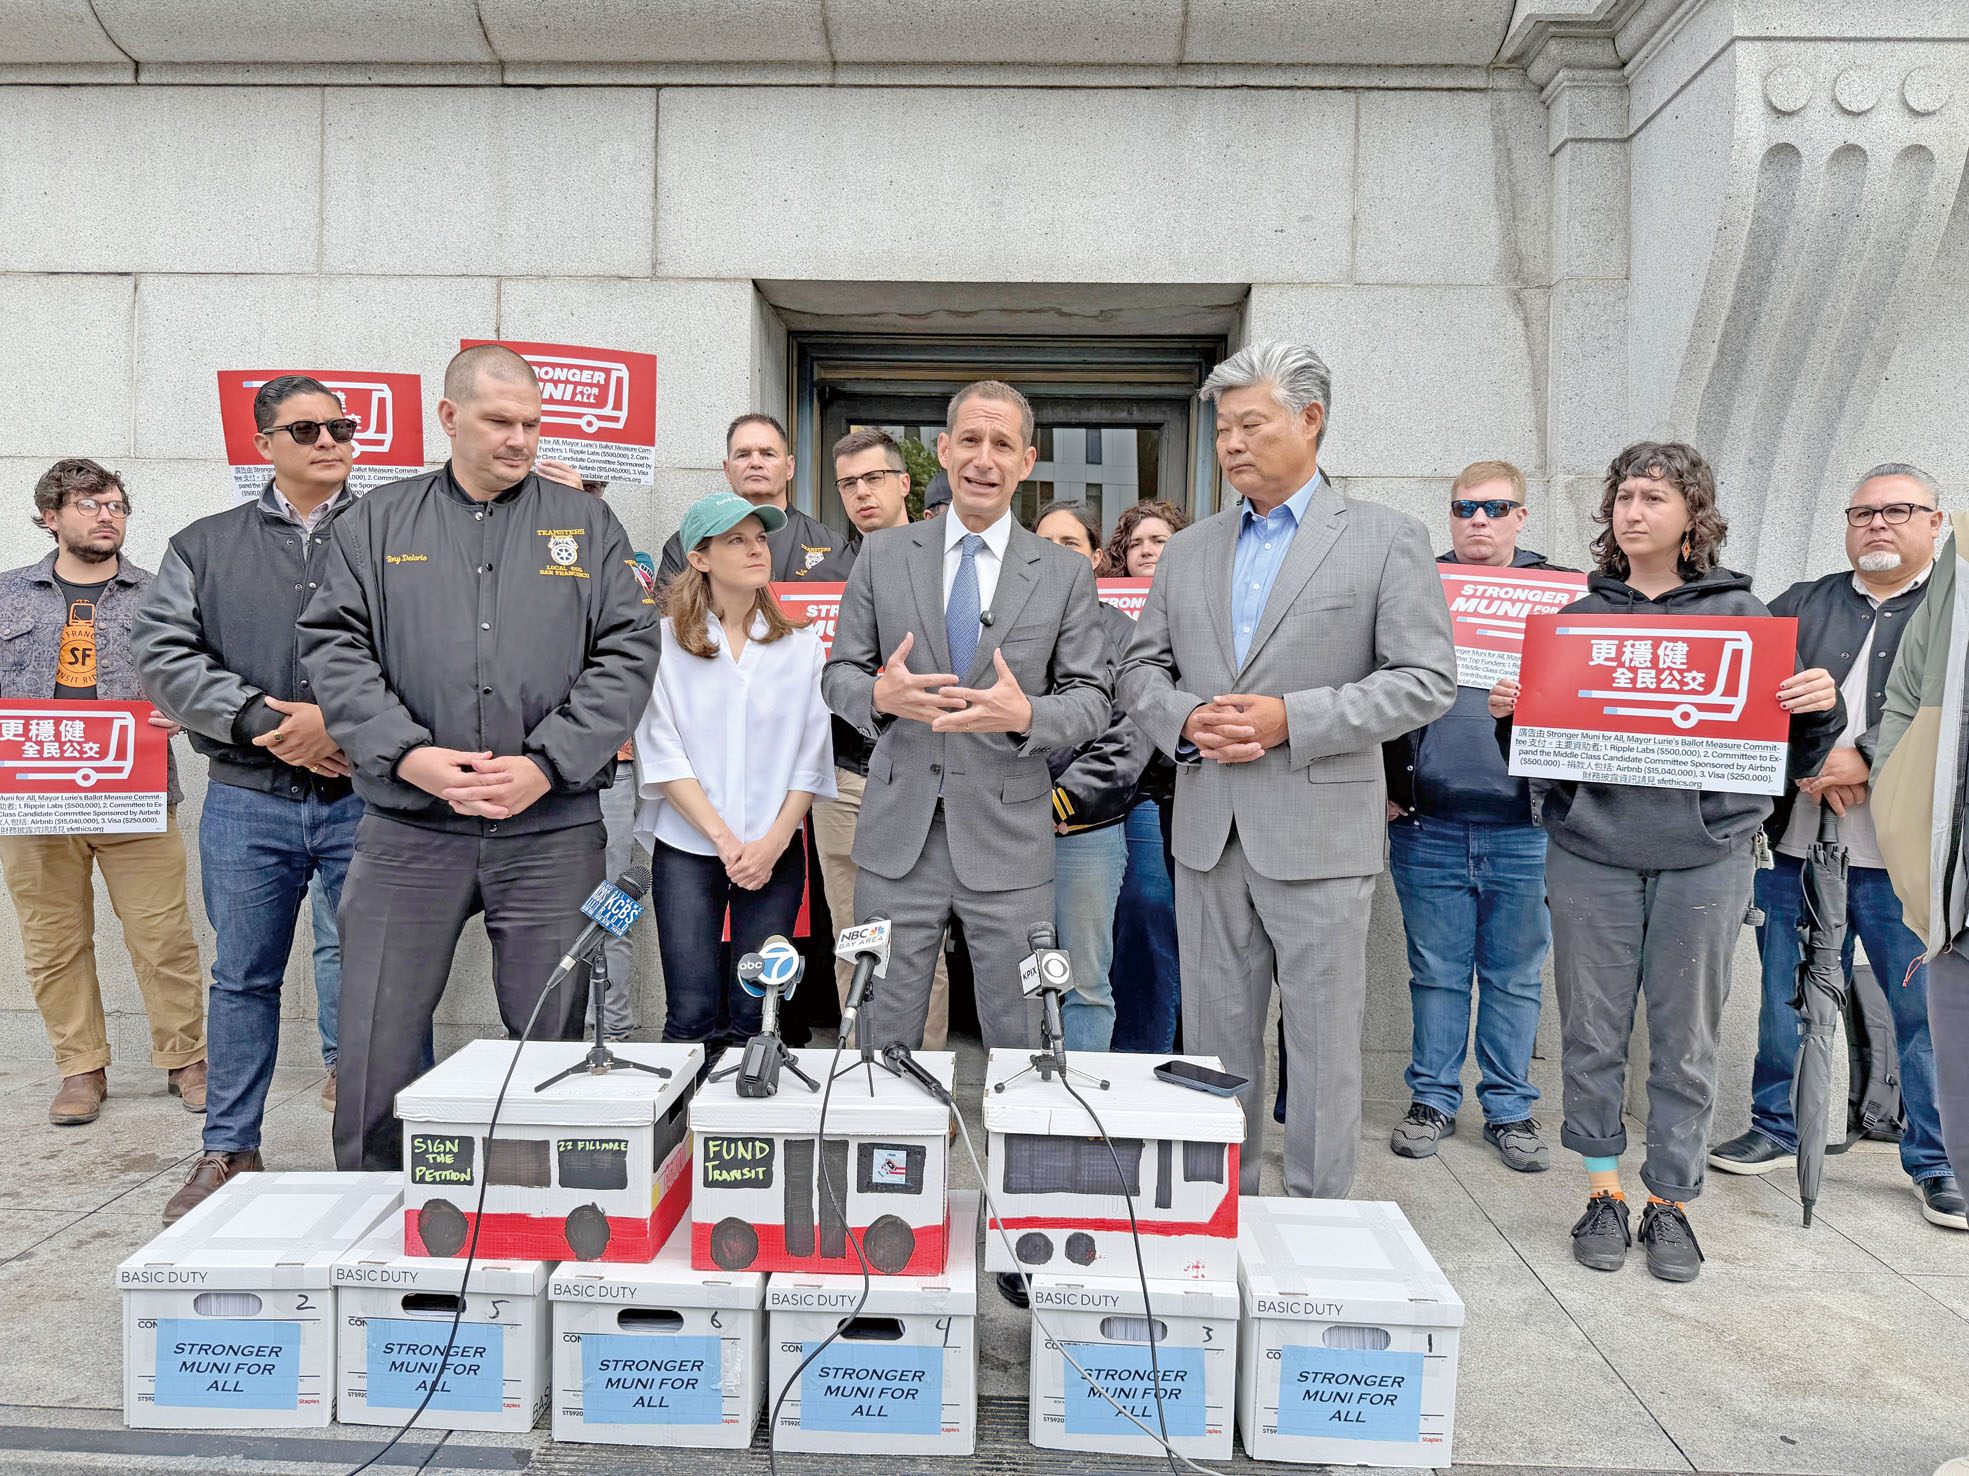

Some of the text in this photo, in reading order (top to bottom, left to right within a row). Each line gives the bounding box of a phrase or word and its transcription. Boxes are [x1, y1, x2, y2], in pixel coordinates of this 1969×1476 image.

[531, 366, 606, 384] RONGER
[538, 382, 575, 400] NI
[576, 386, 599, 395] FOR
[574, 394, 596, 403] ALL
[1461, 584, 1570, 605] STRONGER
[1099, 598, 1146, 608] RON
[1450, 597, 1532, 618] MUNI
[1533, 605, 1559, 614] FOR
[806, 605, 840, 618] STR
[66, 631, 95, 639] FRANC
[804, 620, 837, 637] MU
[68, 647, 92, 666] SF
[1588, 639, 1690, 669] 更穩健
[57, 670, 96, 683] NSIT RID
[1612, 668, 1706, 692] 全民公交
[1, 719, 85, 742] 更穩健
[1547, 730, 1579, 740] Stronger
[1614, 734, 1625, 743] All,
[1627, 736, 1652, 744] Mayor
[1654, 737, 1679, 745] Lurie's
[1681, 739, 1704, 747] Ballot
[1706, 741, 1742, 749] Measure
[1743, 743, 1780, 751] Commit-
[21, 742, 100, 759] 全民公交
[1610, 744, 1635, 753] Ripple
[1636, 746, 1655, 754] Labs
[1657, 747, 1702, 758] ($500,000),
[1711, 752, 1757, 761] Committee
[1520, 758, 1560, 768] ($500,000)
[1616, 765, 1642, 773] Airbnb
[1727, 772, 1773, 783] ($250,000).
[1603, 754, 1642, 763] Candidate
[1644, 757, 1688, 766] Committee
[1690, 760, 1734, 769] Sponsored
[1736, 763, 1746, 772] by
[1748, 764, 1776, 772] Airbnb
[604, 893, 638, 924] KCBS
[600, 907, 628, 930] RADIO
[841, 928, 869, 942] NBC
[839, 936, 884, 950] BAY AREA
[740, 960, 763, 970] abc
[1022, 966, 1037, 981] KPIX
[414, 1139, 459, 1153] SIGN
[558, 1142, 627, 1151] 22 FILLMORE
[709, 1141, 769, 1160] FUND
[426, 1154, 455, 1164] THE
[416, 1167, 471, 1181] PETITION
[122, 1271, 208, 1283] BASIC DUTY
[336, 1269, 418, 1283] BASIC DUTY
[553, 1283, 637, 1299] BASIC DUTY
[296, 1294, 316, 1310] 2
[771, 1293, 857, 1308] BASIC DUTY
[1035, 1291, 1120, 1308] BASIC DUTY
[488, 1299, 510, 1319] 5
[1258, 1300, 1344, 1316] BASIC DUTY
[138, 1321, 157, 1329] CON
[348, 1319, 368, 1327] CON
[710, 1310, 723, 1329] 6
[563, 1334, 582, 1343] CON
[935, 1316, 952, 1348] 4
[1202, 1327, 1214, 1342] 3
[781, 1344, 802, 1353] CON
[1045, 1342, 1066, 1350] CO
[1428, 1333, 1433, 1352] 1
[173, 1343, 283, 1359] STRONGER
[383, 1342, 487, 1359] STRONGER
[1266, 1351, 1281, 1360] CO
[179, 1361, 276, 1376] MUNI FOR
[389, 1361, 481, 1376] MUNI FOR
[599, 1359, 705, 1373] STRONGER
[818, 1366, 926, 1383] STRONGER
[1081, 1368, 1187, 1382] STRONGER
[1297, 1371, 1405, 1388] STRONGER
[207, 1379, 245, 1393] ALL
[415, 1380, 451, 1393] ALL
[605, 1377, 698, 1391] MUNI FOR
[824, 1384, 919, 1400] MUNI FOR
[1087, 1387, 1182, 1400] MUNI FOR
[1302, 1389, 1398, 1406] MUNI FOR
[632, 1395, 670, 1409] ALL
[851, 1404, 889, 1418] ALL
[1115, 1405, 1153, 1418] ALL
[1329, 1409, 1367, 1423] ALL
